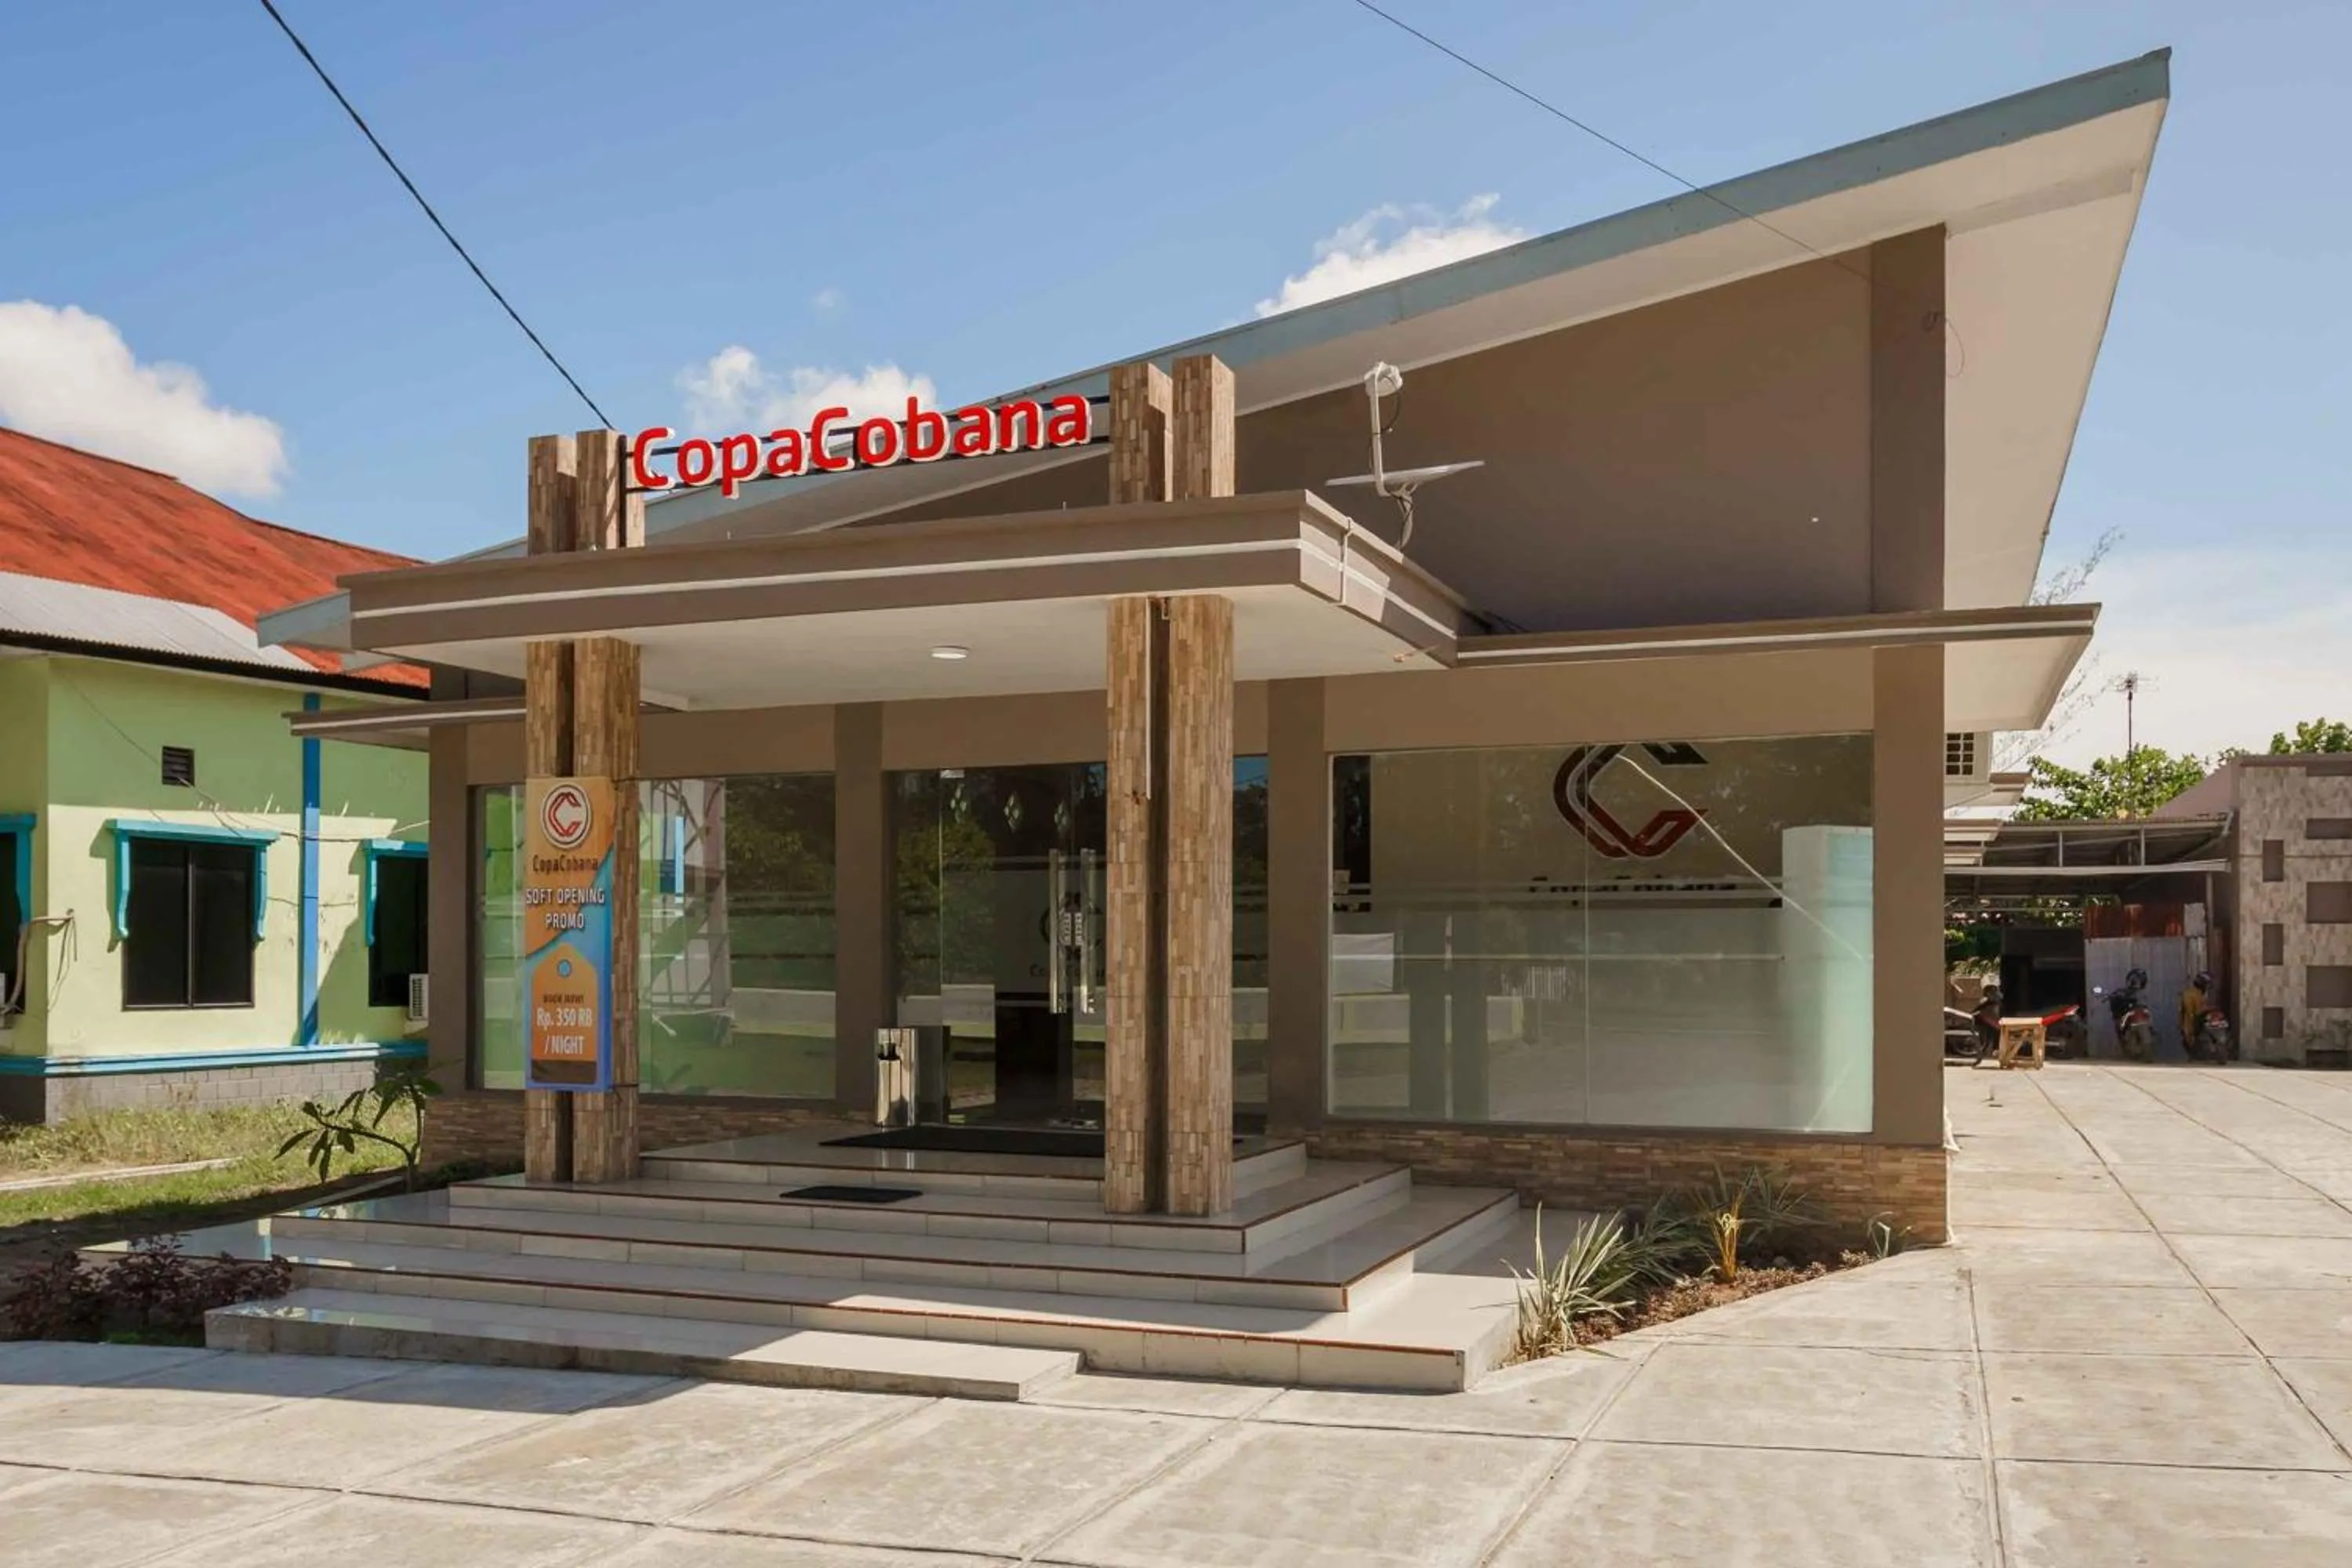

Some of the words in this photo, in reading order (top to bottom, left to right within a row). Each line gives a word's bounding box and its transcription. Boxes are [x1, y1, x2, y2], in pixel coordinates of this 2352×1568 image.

[633, 394, 1091, 499] CopaCobana
[532, 854, 598, 875] CopaCobana
[526, 887, 553, 904] SOFT
[557, 887, 605, 904] OPENING
[545, 912, 585, 929] PROMO
[537, 1007, 554, 1031] Rp.
[556, 1007, 576, 1027] 350
[578, 1008, 593, 1028] RB
